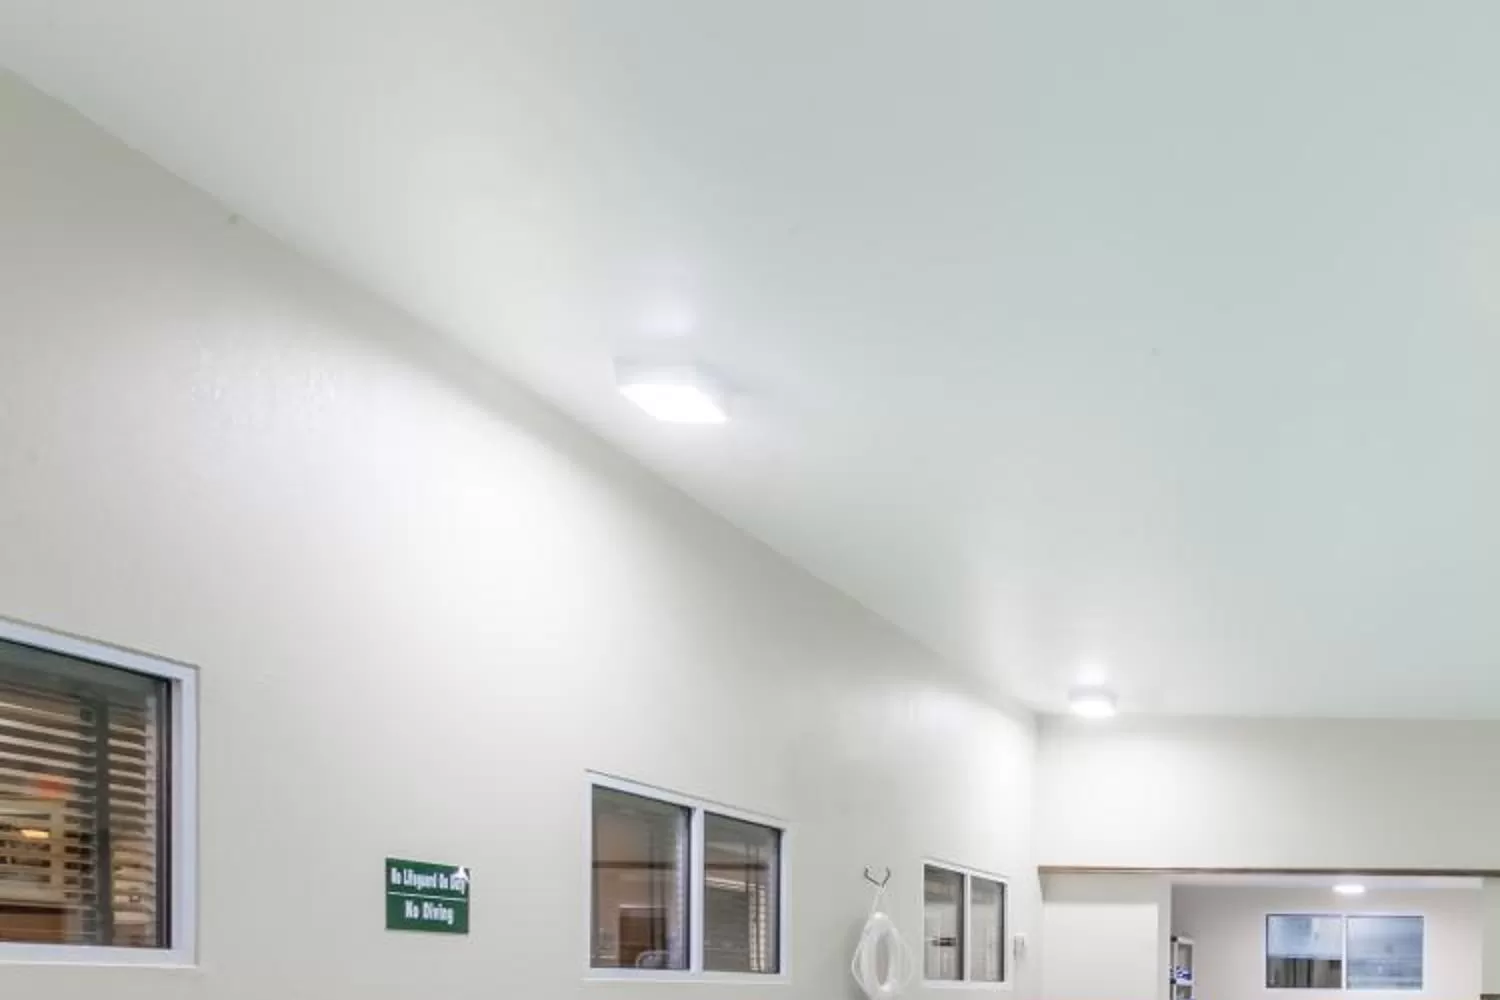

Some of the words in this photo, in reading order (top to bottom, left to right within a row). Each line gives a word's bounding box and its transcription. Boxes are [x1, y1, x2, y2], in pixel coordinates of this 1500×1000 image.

[391, 866, 402, 885] No
[403, 867, 437, 890] Lifeguard
[405, 899, 420, 919] No
[422, 901, 454, 925] Diving
